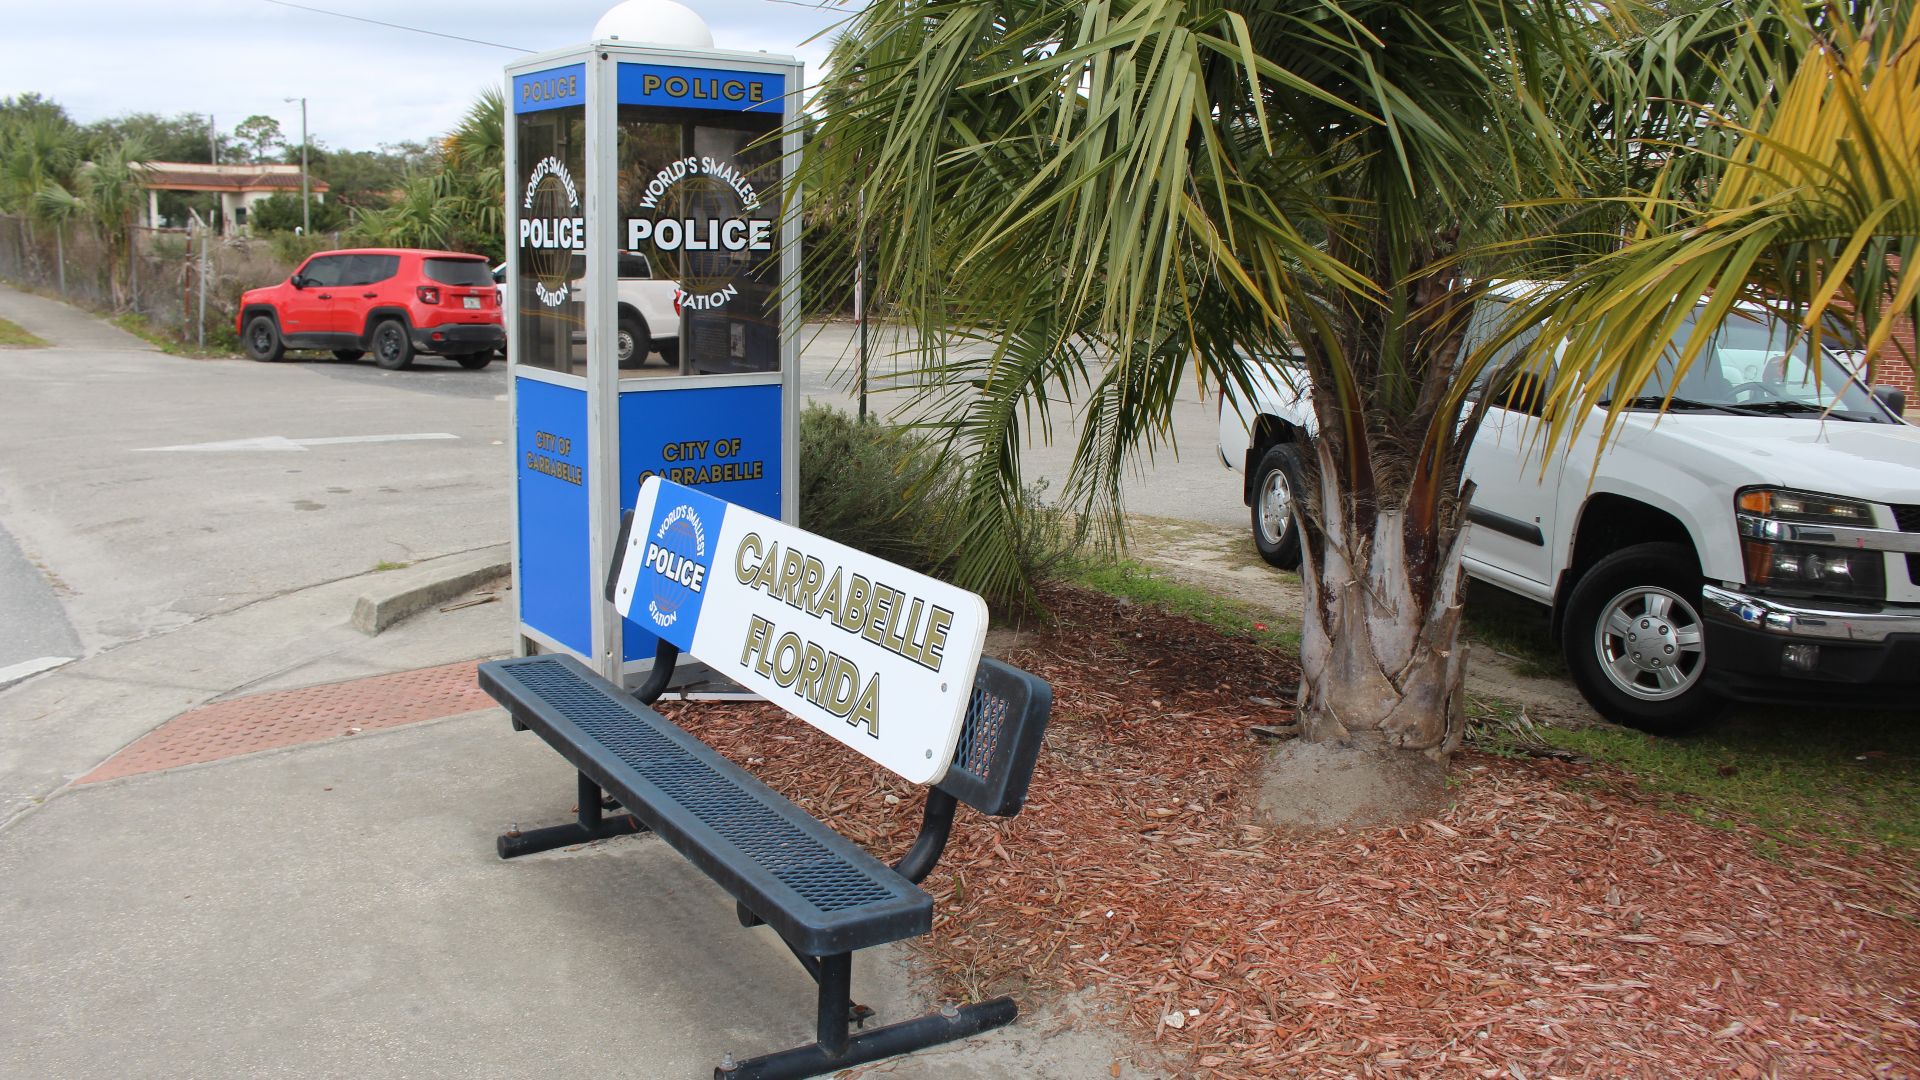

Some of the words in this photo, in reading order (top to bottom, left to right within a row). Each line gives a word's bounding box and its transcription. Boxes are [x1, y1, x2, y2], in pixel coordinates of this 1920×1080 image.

[523, 75, 577, 103] POLICE
[643, 74, 764, 102] POLICE
[524, 156, 550, 209] WORLD'S
[549, 156, 579, 209] SMALLEST
[639, 156, 698, 209] WORLD'S
[701, 156, 761, 211] SMALLEST
[519, 216, 585, 249] POLICE
[627, 217, 773, 251] POLICE
[535, 281, 568, 307] STATION
[535, 430, 556, 450] CITY
[557, 438, 572, 458] OF
[662, 441, 709, 462] CITY
[714, 438, 742, 456] OF
[526, 452, 583, 486] CARRABELLE
[657, 504, 687, 540] WORLD'S
[686, 506, 705, 557] SMALLEST
[645, 541, 706, 594] POLICE
[649, 600, 677, 627] STATION
[735, 532, 954, 673] CARRABELLE
[740, 613, 880, 740] FLORIDA
